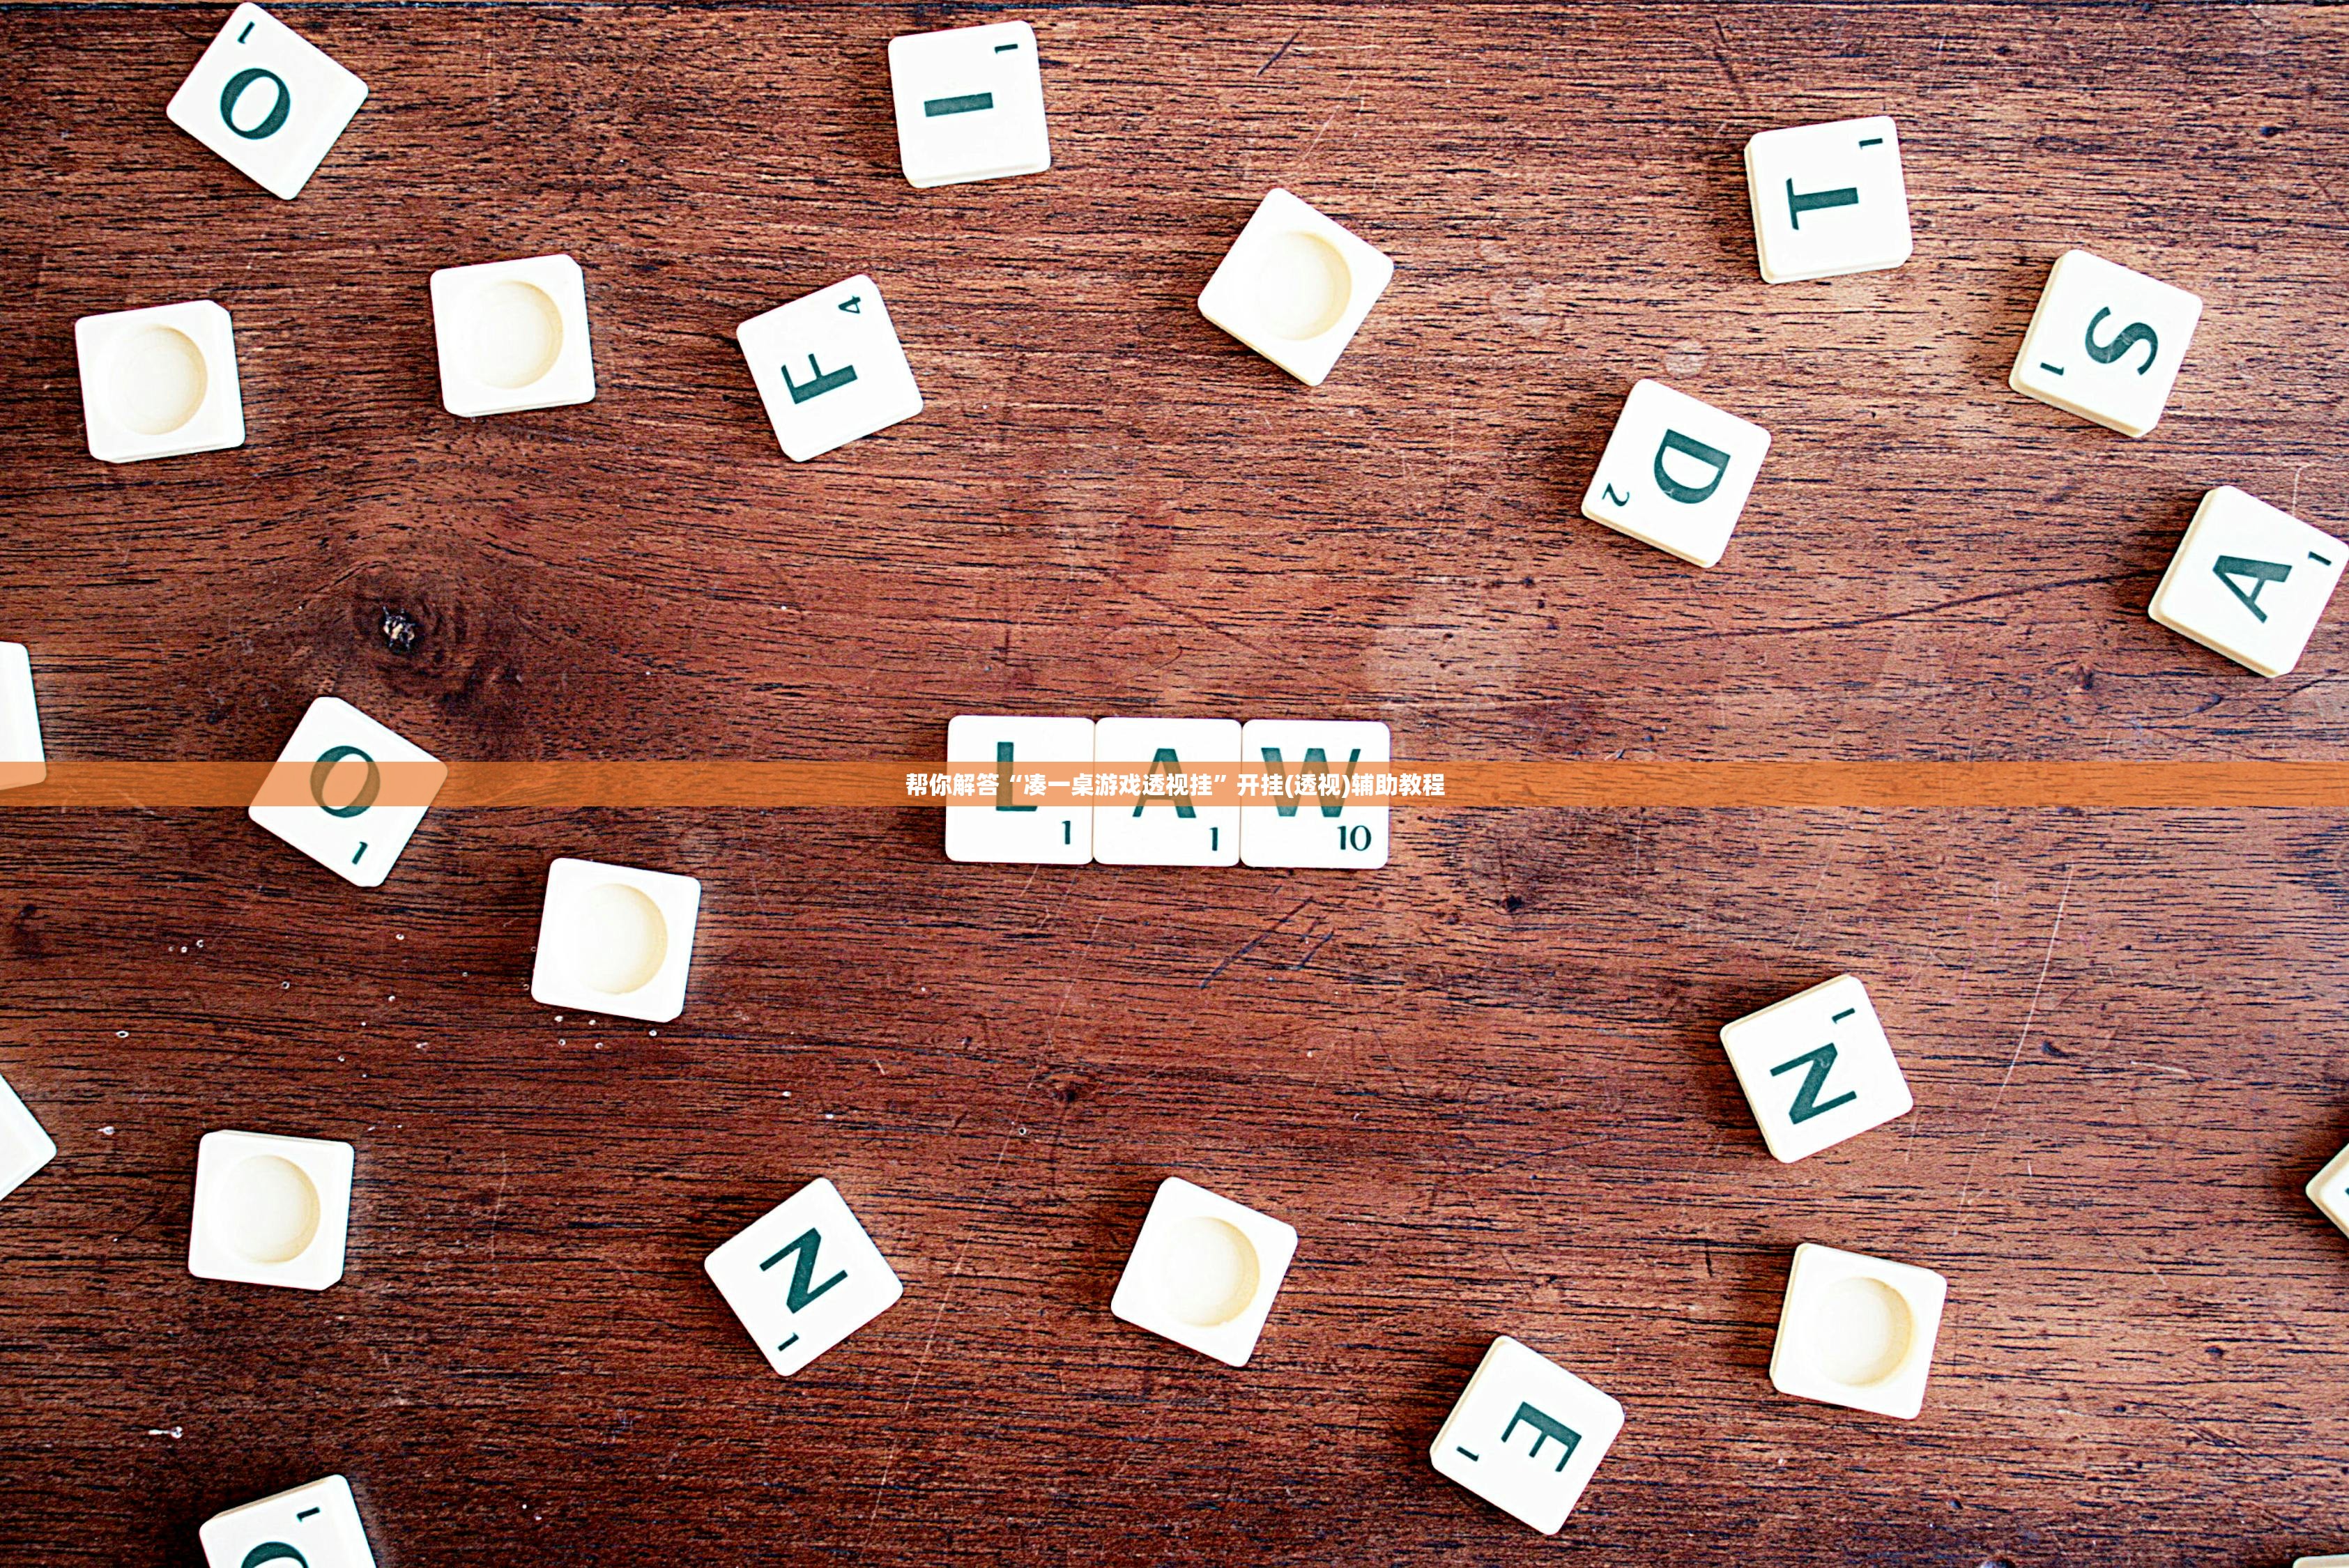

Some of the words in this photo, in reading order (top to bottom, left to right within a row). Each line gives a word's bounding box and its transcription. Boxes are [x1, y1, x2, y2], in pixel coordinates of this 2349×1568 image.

[239, 22, 256, 45] 1
[995, 43, 1019, 54] 1
[220, 68, 291, 141] O
[924, 93, 995, 118] I
[1858, 137, 1885, 149] 1
[1786, 178, 1860, 231] T
[838, 297, 862, 316] 4
[2085, 307, 2159, 376] S
[781, 354, 859, 406] F
[2040, 362, 2065, 377] 1
[1653, 429, 1731, 505] D
[1602, 484, 1629, 507] 2
[2308, 551, 2332, 567] 1
[2213, 555, 2293, 624] A
[310, 745, 381, 819] O
[1061, 820, 1071, 846] 1
[1209, 827, 1219, 852] 1
[1337, 825, 1372, 852] 10
[351, 841, 369, 866] 1
[1832, 1008, 1857, 1024] 1
[1770, 1043, 1858, 1125] N
[760, 1228, 849, 1315] N
[777, 1332, 801, 1353] 1
[1501, 1401, 1583, 1473] E
[1457, 1447, 1480, 1463] 1
[296, 1507, 321, 1523] 1
